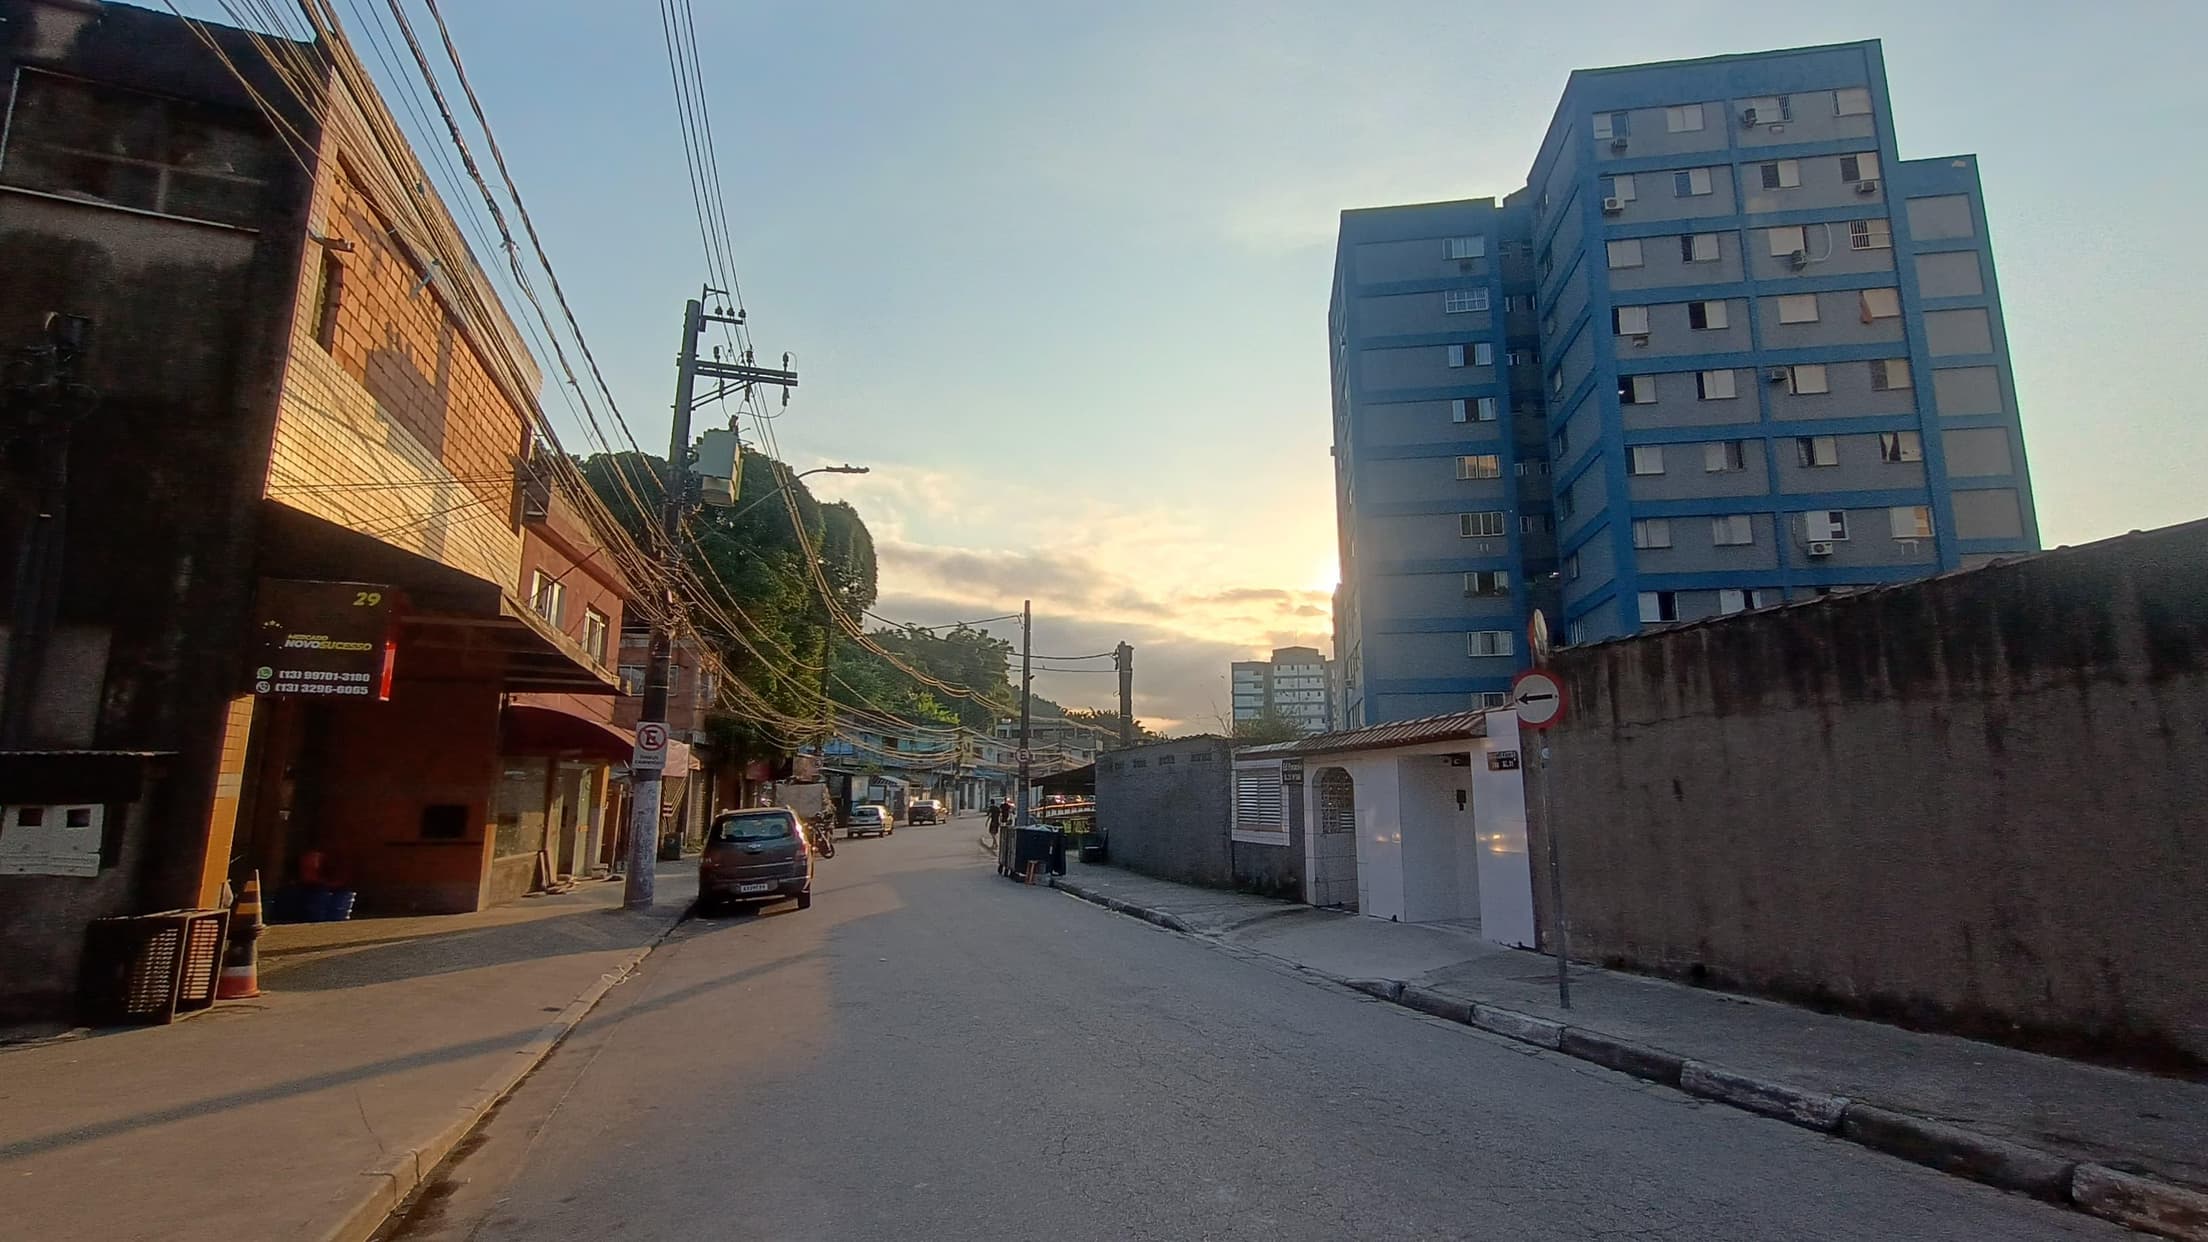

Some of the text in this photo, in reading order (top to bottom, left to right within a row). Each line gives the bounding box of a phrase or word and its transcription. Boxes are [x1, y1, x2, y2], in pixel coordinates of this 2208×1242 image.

[353, 592, 381, 606] 29
[279, 670, 302, 679] (13)
[275, 683, 299, 692] (13)
